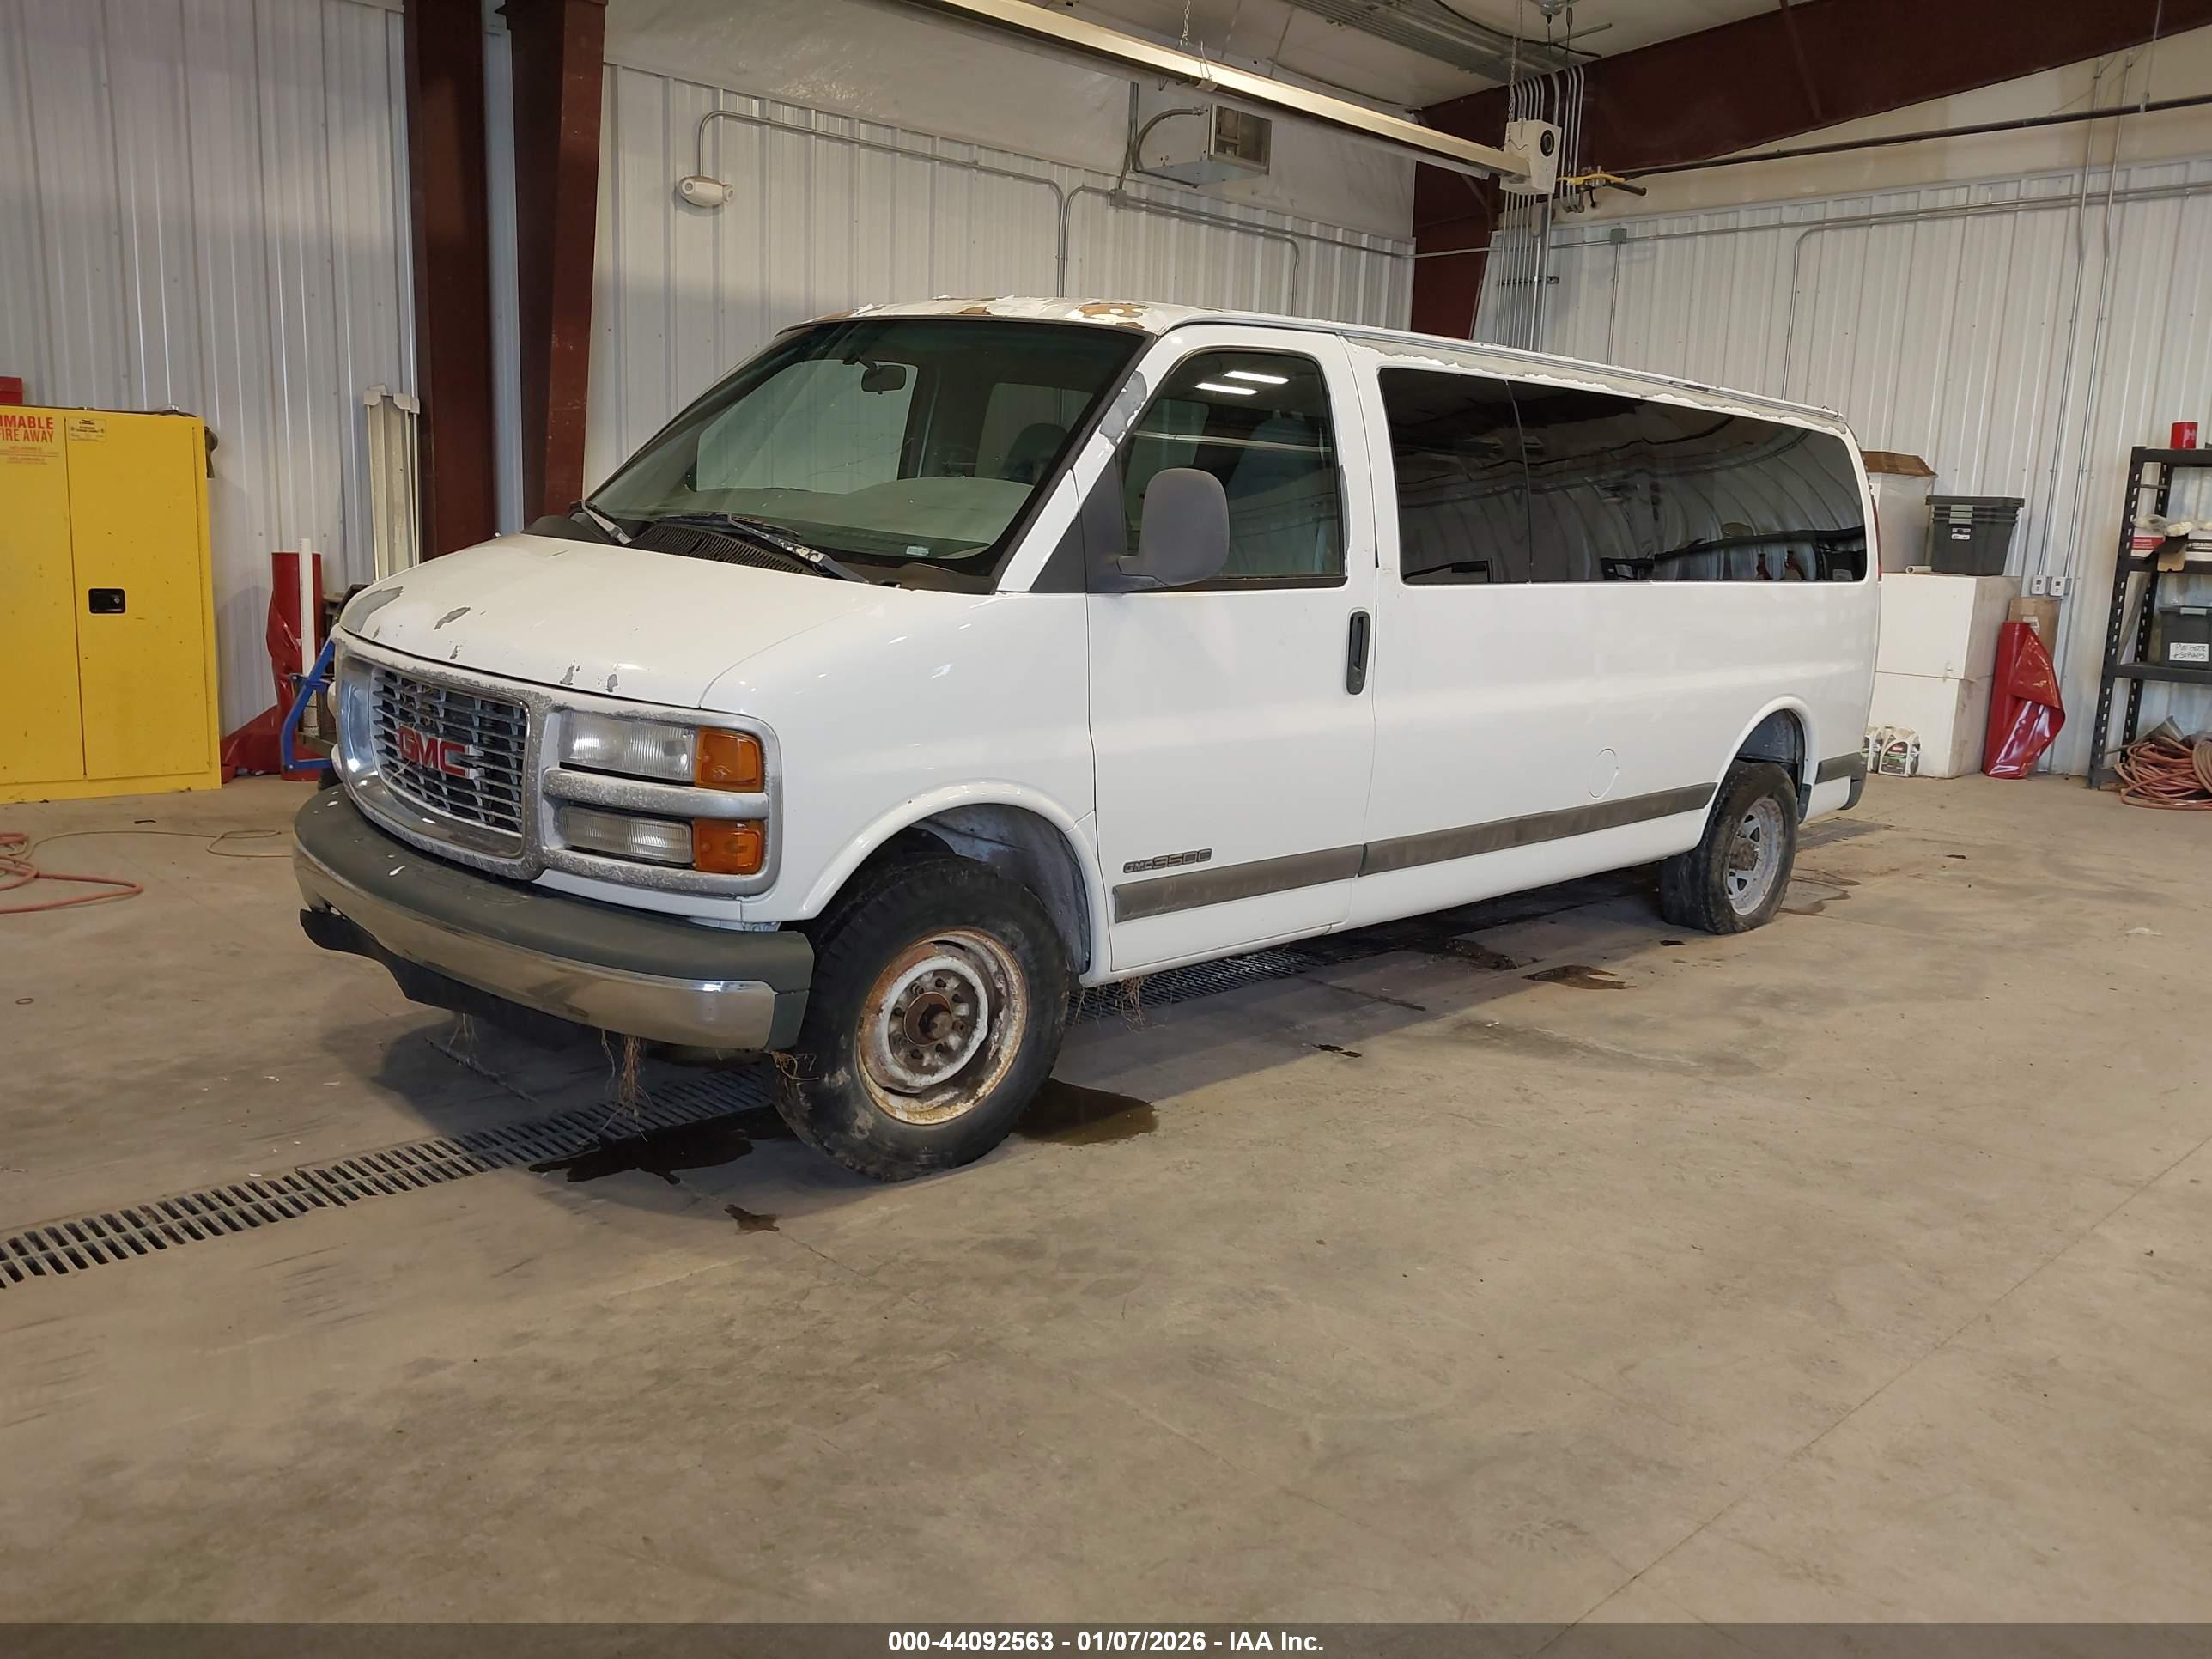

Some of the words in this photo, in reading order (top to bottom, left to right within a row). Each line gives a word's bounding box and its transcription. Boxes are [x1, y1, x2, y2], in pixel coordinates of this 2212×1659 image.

[0, 414, 54, 429] MABLE
[22, 428, 54, 443] AWAY
[398, 724, 468, 779] GMC
